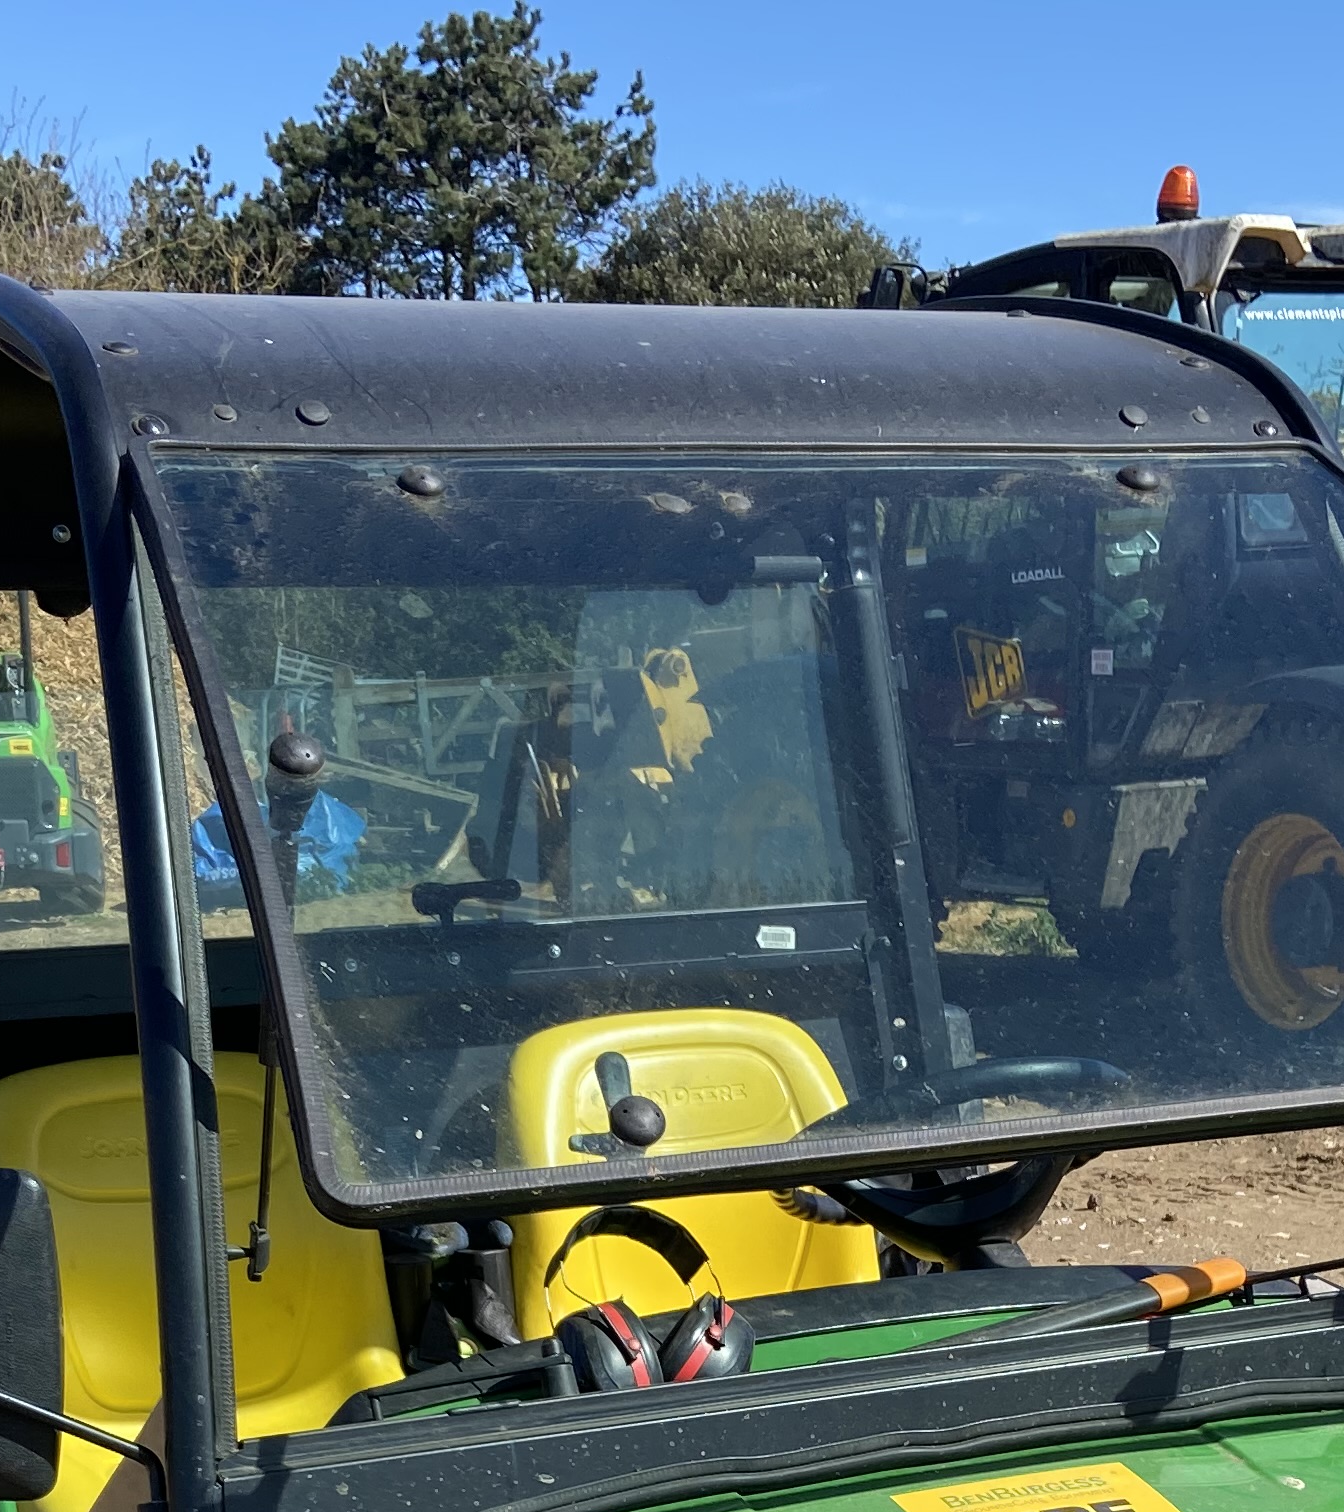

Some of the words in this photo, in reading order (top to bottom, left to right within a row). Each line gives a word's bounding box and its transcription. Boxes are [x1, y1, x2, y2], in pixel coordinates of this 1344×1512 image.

[1011, 566, 1066, 584] LOADALL
[967, 636, 1022, 710] JCB
[670, 1083, 748, 1105] DEERE
